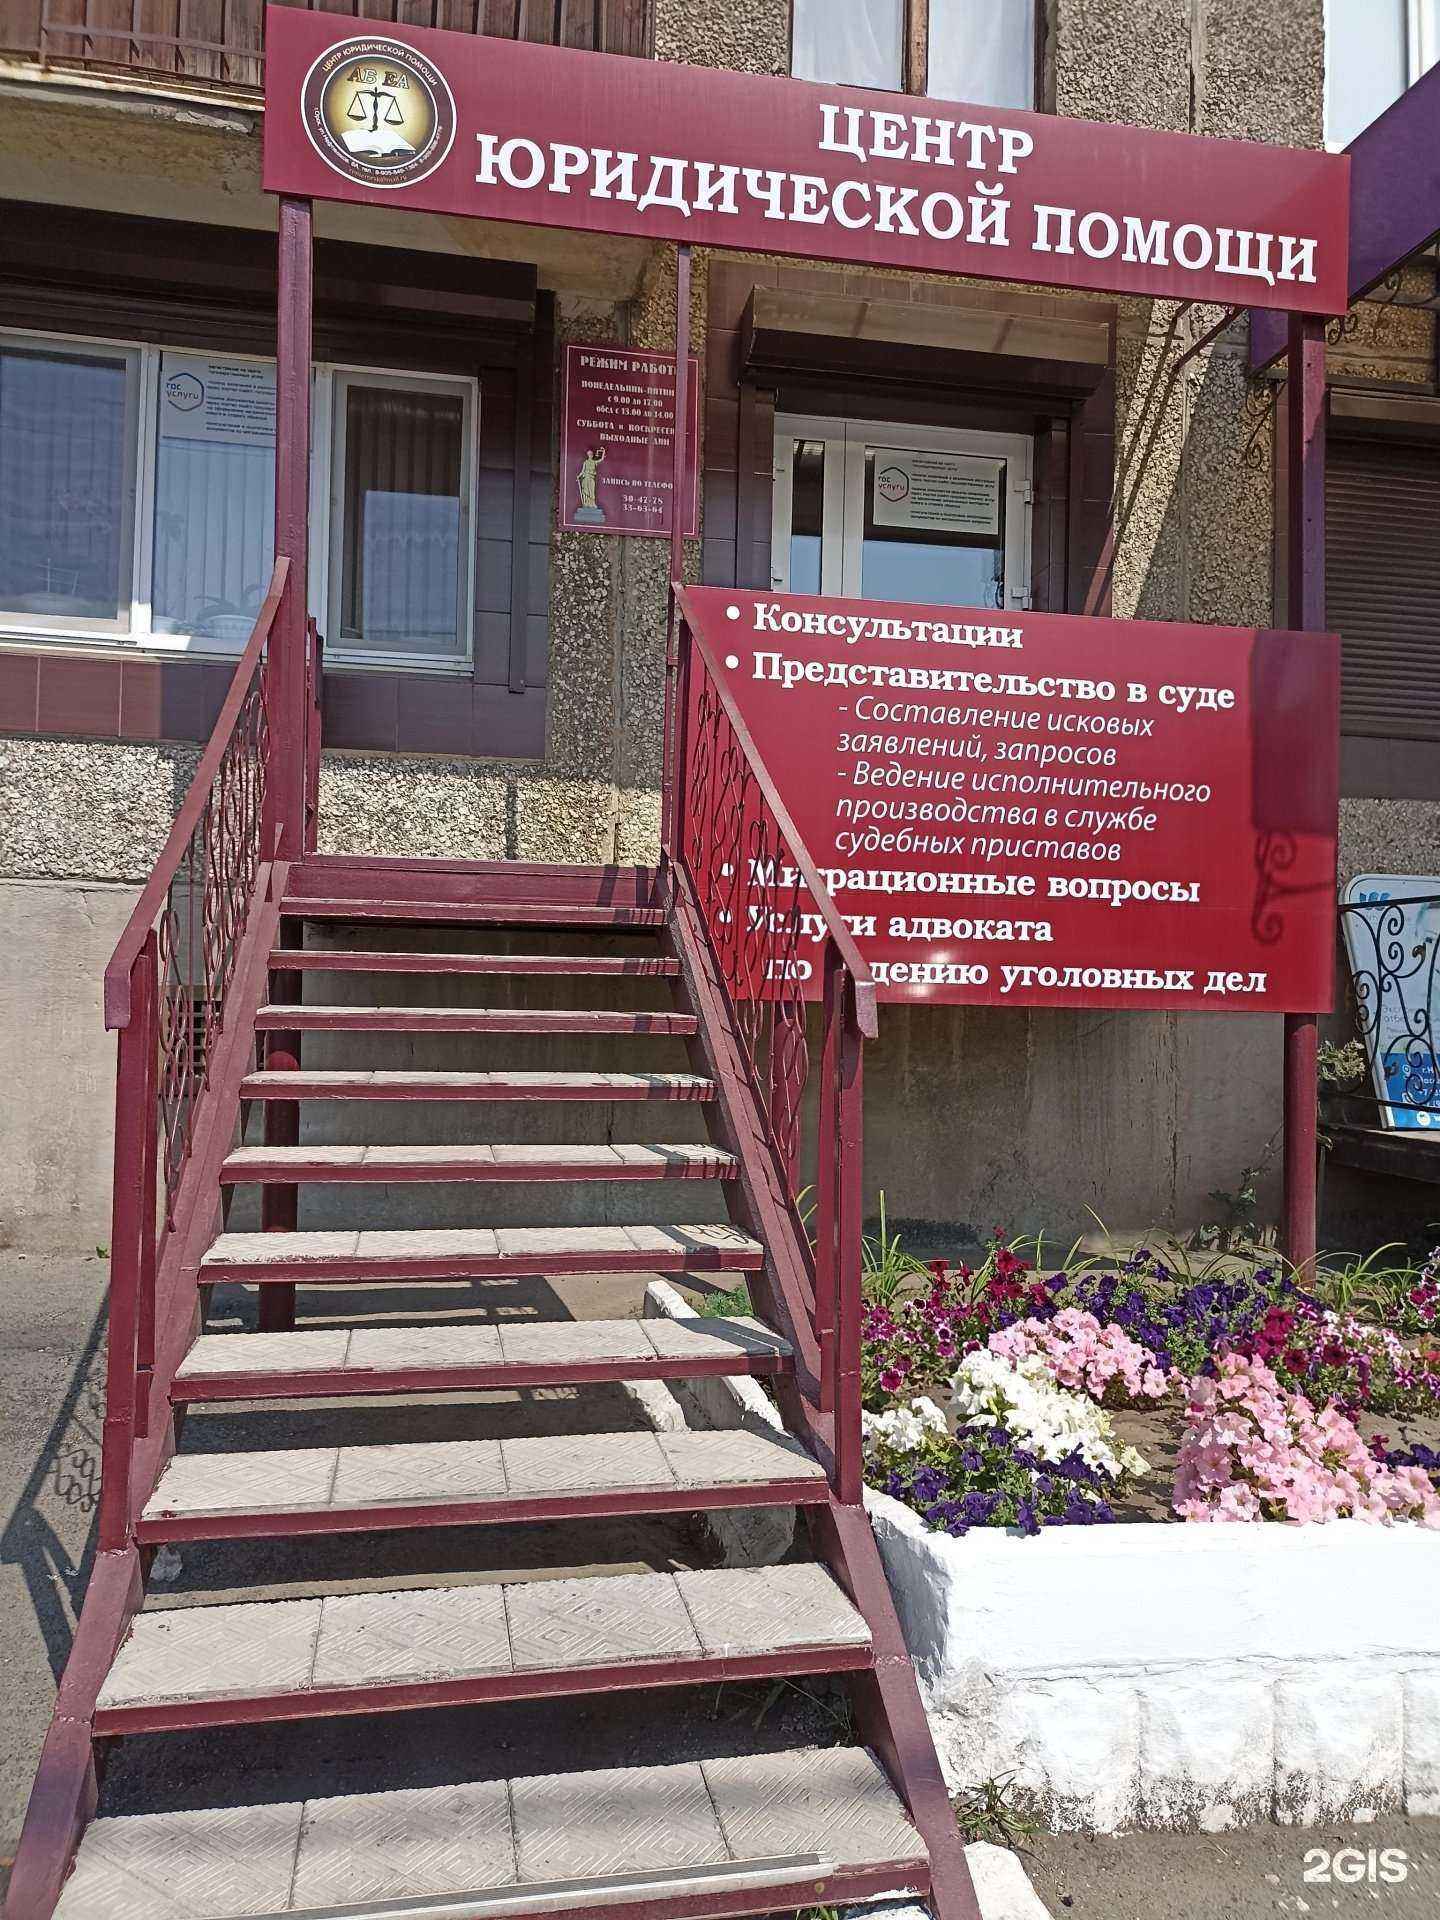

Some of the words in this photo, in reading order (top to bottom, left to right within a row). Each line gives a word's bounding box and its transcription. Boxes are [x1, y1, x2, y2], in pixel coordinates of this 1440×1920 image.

[322, 53, 342, 72] ЦЕНТР
[343, 43, 405, 58] ЮРИДИЧЕСКОЙ
[405, 53, 438, 86] ПОМОЩИ
[818, 103, 1034, 174] ЦЕНТР
[475, 132, 1011, 247] ЮРИДИЧЕСКОЙ
[1032, 204, 1318, 287] ПОМОЩИ
[580, 355, 628, 371] РЕЖИМ
[632, 361, 676, 376] РАБОТ
[576, 419, 614, 431] СУББОТА
[628, 423, 675, 437] ВОСКРЕСЕН
[600, 432, 649, 445] ВЫХОДНЫЕ
[753, 602, 1024, 649] Консультации
[752, 650, 1116, 702] Представительство
[1126, 682, 1148, 704] в
[1158, 684, 1235, 713] суде
[855, 695, 1042, 731] Составление
[1047, 712, 1155, 737] исковых
[836, 732, 988, 763] заявлений,
[994, 741, 1117, 768] запросов
[853, 760, 965, 791] Ведение
[971, 774, 1212, 803] исполнительного
[836, 797, 1038, 826] производства
[1044, 808, 1058, 827] в
[1064, 806, 1158, 835] службе
[835, 825, 964, 857] судебных
[970, 841, 1121, 862] приставов
[1048, 876, 1201, 907] вопросы
[888, 915, 1054, 942] адвоката
[766, 959, 813, 980] по
[843, 960, 990, 988] дению
[1000, 964, 1194, 993] уголовных
[1204, 970, 1268, 995] дел
